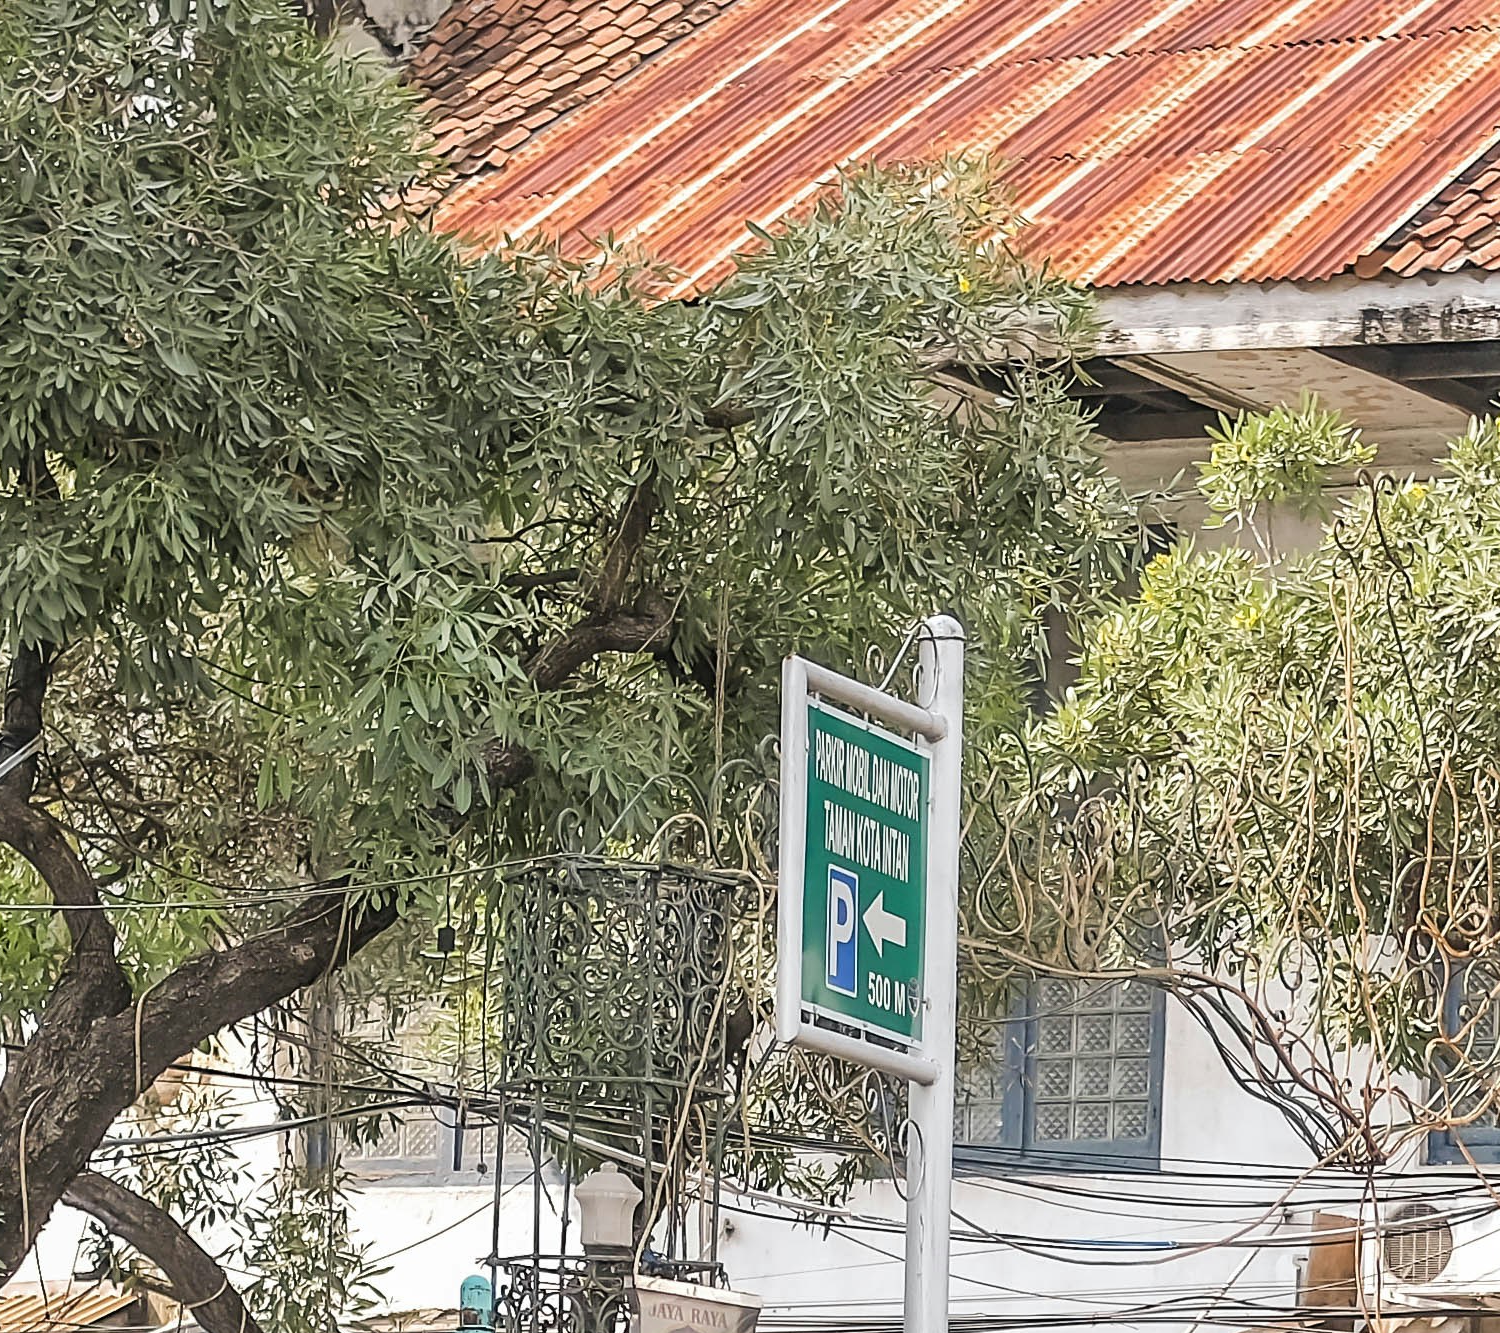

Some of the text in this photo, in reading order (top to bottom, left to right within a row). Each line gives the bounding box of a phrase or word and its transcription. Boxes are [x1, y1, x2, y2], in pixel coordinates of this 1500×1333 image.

[815, 728, 919, 822] PARKIR MOBIL DAN MOTOR
[824, 800, 910, 883] TAMAN KOTA INTAN
[829, 877, 855, 978] P
[868, 971, 906, 1017] 500 M
[649, 1304, 728, 1328] JAYA RAYA
